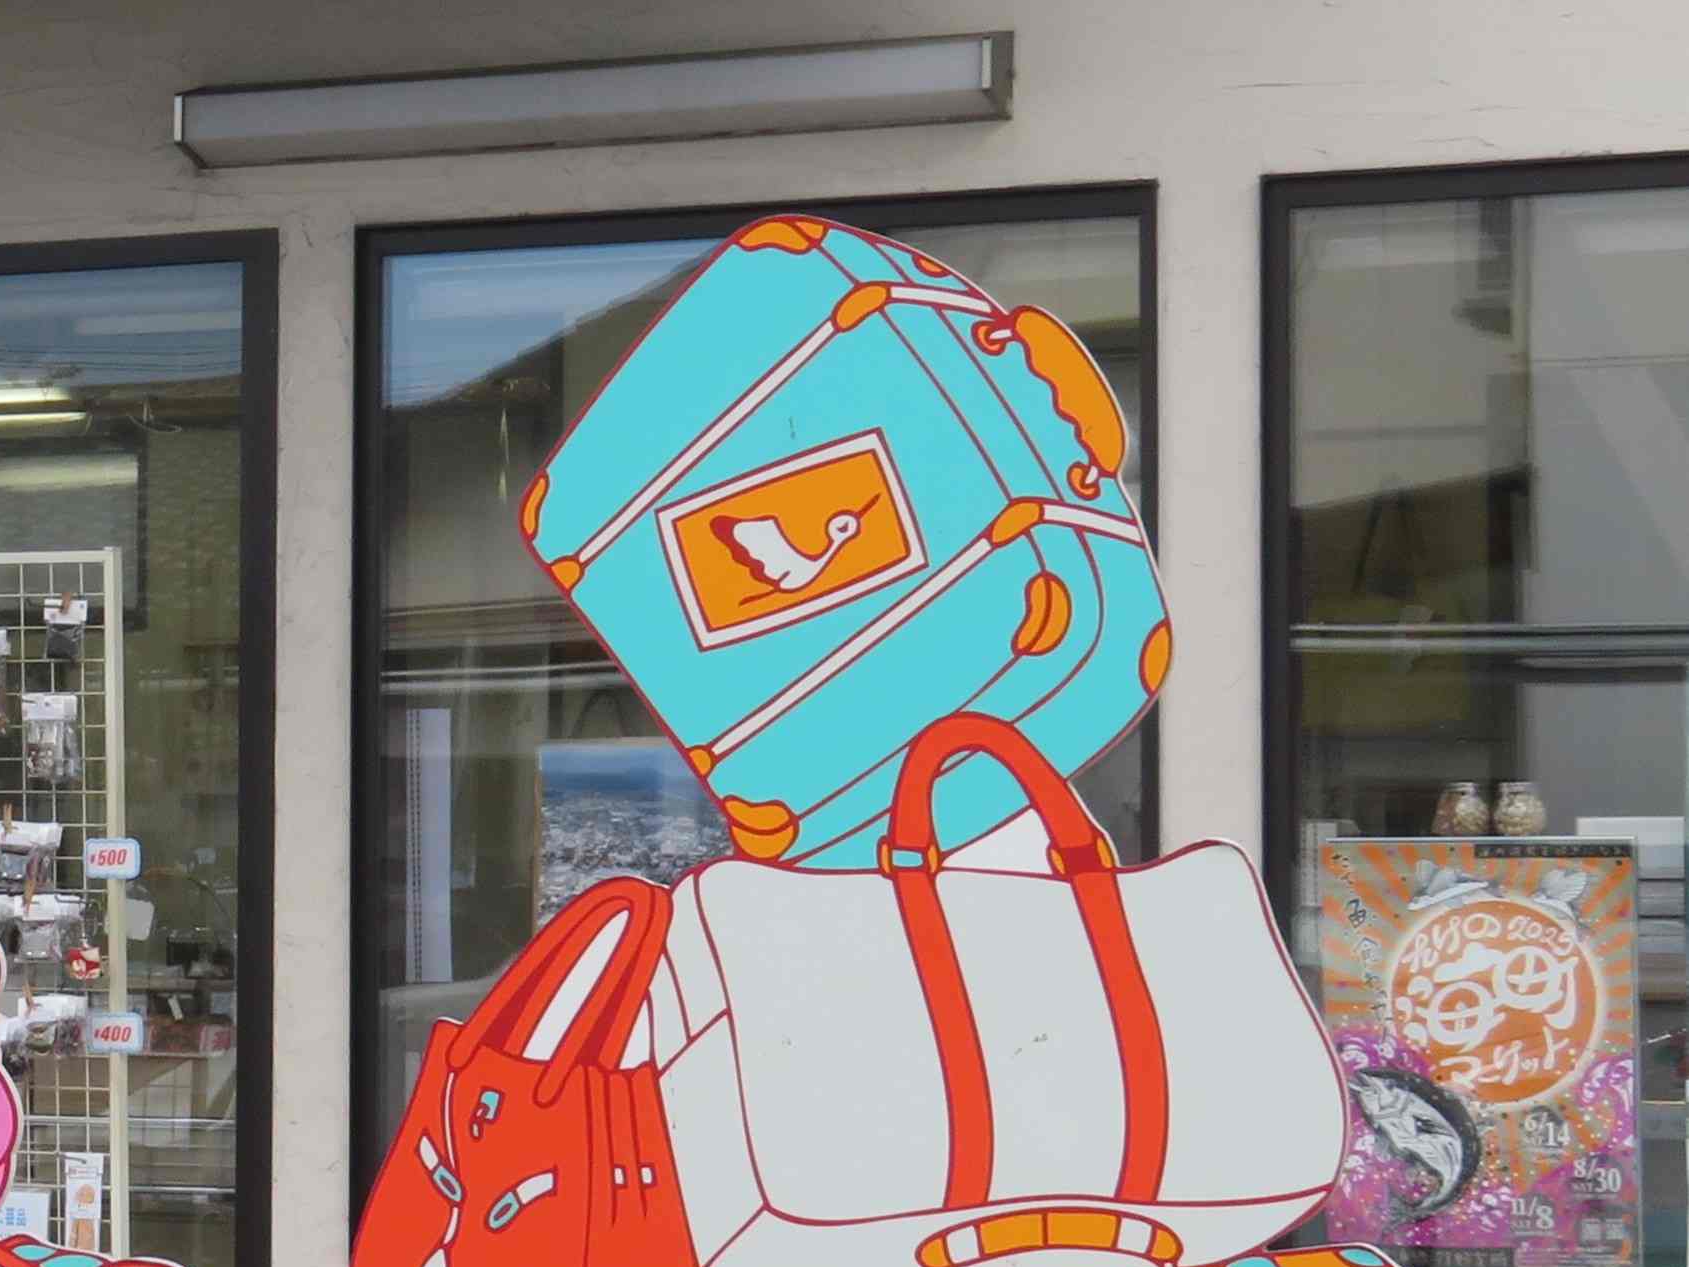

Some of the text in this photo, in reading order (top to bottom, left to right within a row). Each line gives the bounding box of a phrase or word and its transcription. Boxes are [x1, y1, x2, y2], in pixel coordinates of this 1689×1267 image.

[1524, 1112, 1571, 1147] 6/14
[1573, 1157, 1622, 1193] 8/30
[1511, 1197, 1555, 1230] 11/8
